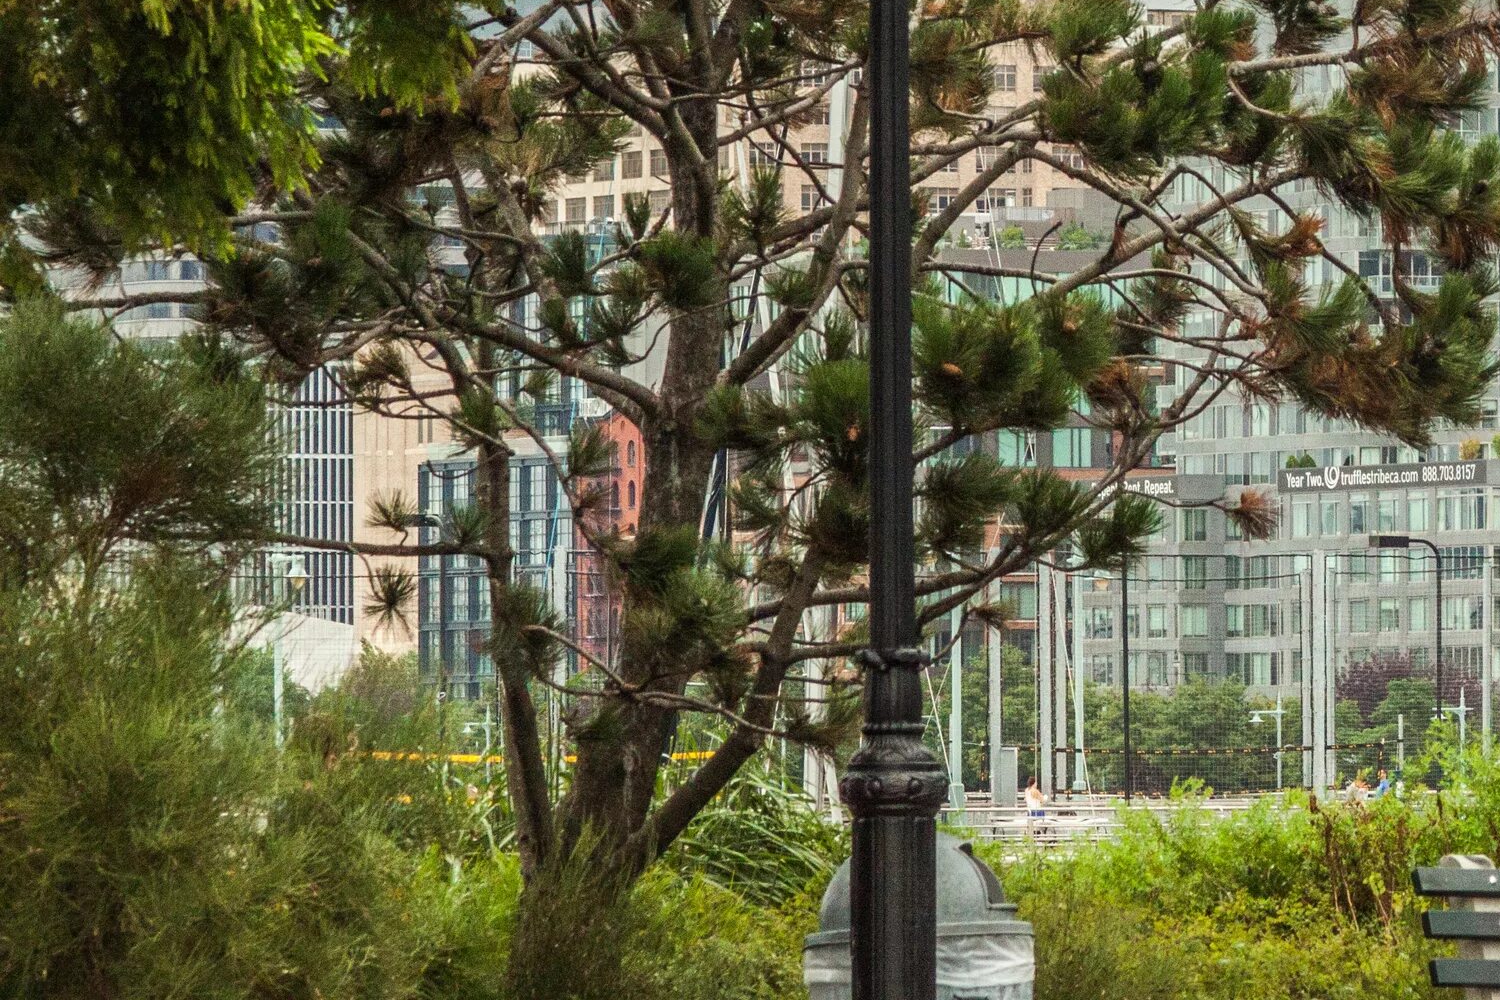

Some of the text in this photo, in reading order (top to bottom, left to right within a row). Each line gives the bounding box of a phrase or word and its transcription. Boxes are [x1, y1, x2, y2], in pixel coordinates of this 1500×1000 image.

[1286, 464, 1476, 488] Year Two. trufflestribeca.com 888.703.8157
[1144, 480, 1174, 497] Repeat.
